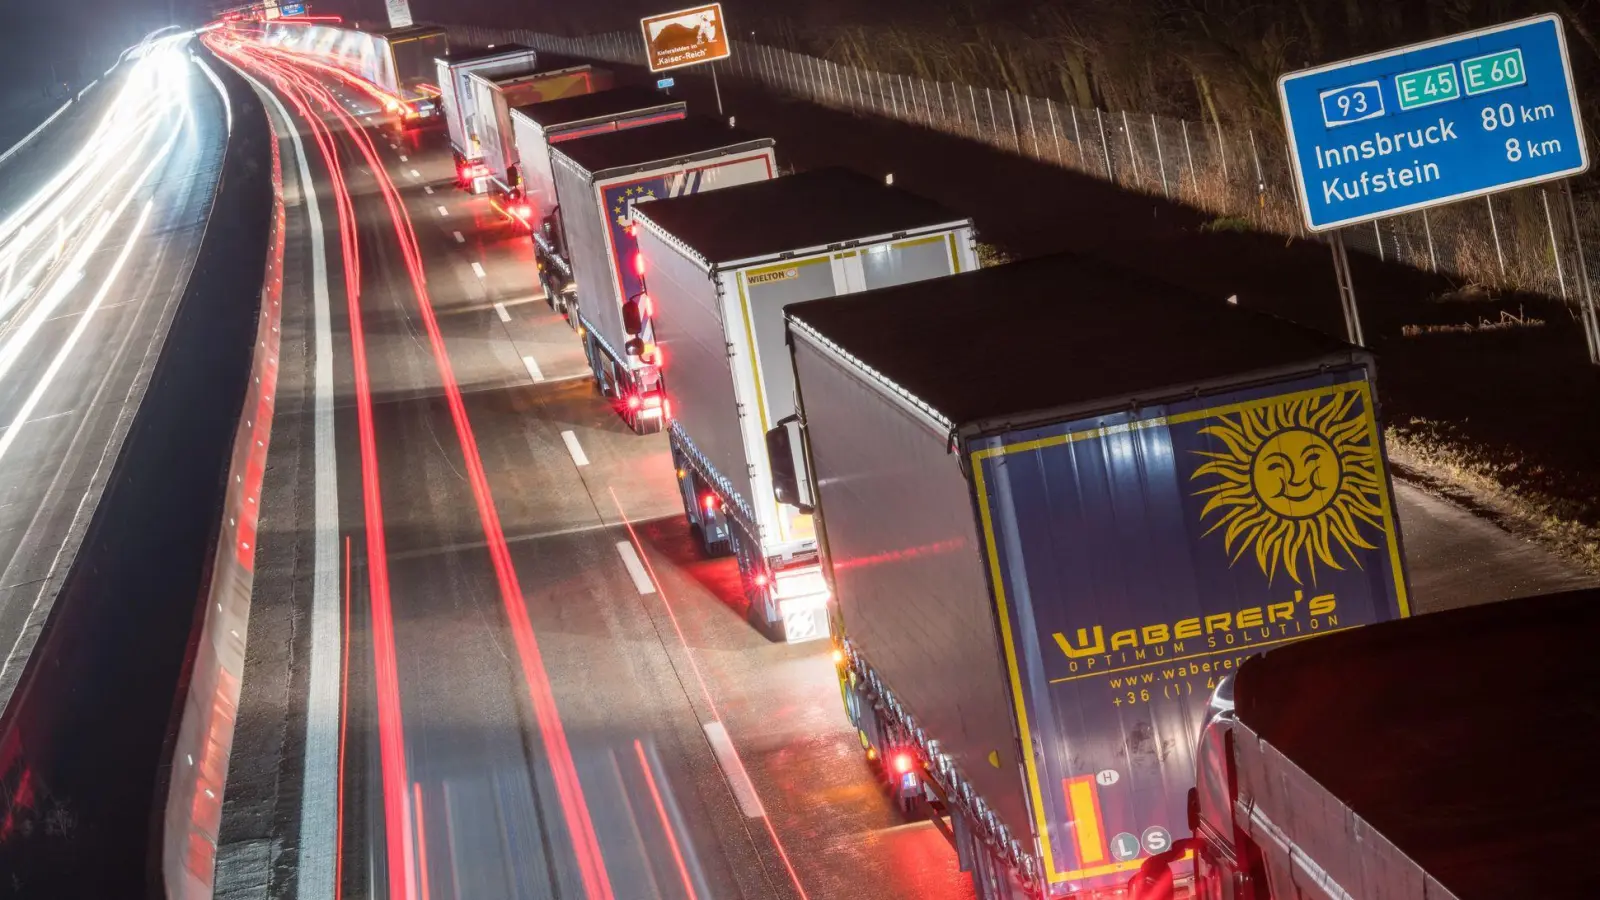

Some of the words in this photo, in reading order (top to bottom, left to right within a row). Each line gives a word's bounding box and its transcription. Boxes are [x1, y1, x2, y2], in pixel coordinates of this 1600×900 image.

[1468, 65, 1485, 87] E
[1491, 57, 1519, 82] 60
[1402, 79, 1419, 102] E
[1423, 71, 1453, 97] 45
[1336, 91, 1368, 117] 93
[1315, 118, 1459, 169] Innsbruck
[1481, 103, 1515, 131] 80
[1520, 104, 1555, 124] km
[1321, 160, 1441, 205] Kufstein
[1505, 138, 1522, 163] 8
[1528, 139, 1562, 159] km
[748, 271, 785, 284] WIELTON
[1069, 642, 1184, 672] OPTIMUM
[1207, 615, 1338, 648] SOLUTION
[1112, 689, 1150, 708] +36
[1164, 681, 1193, 699] (1)
[1103, 772, 1113, 783] H
[1117, 839, 1133, 857] L
[1147, 831, 1166, 850] S
